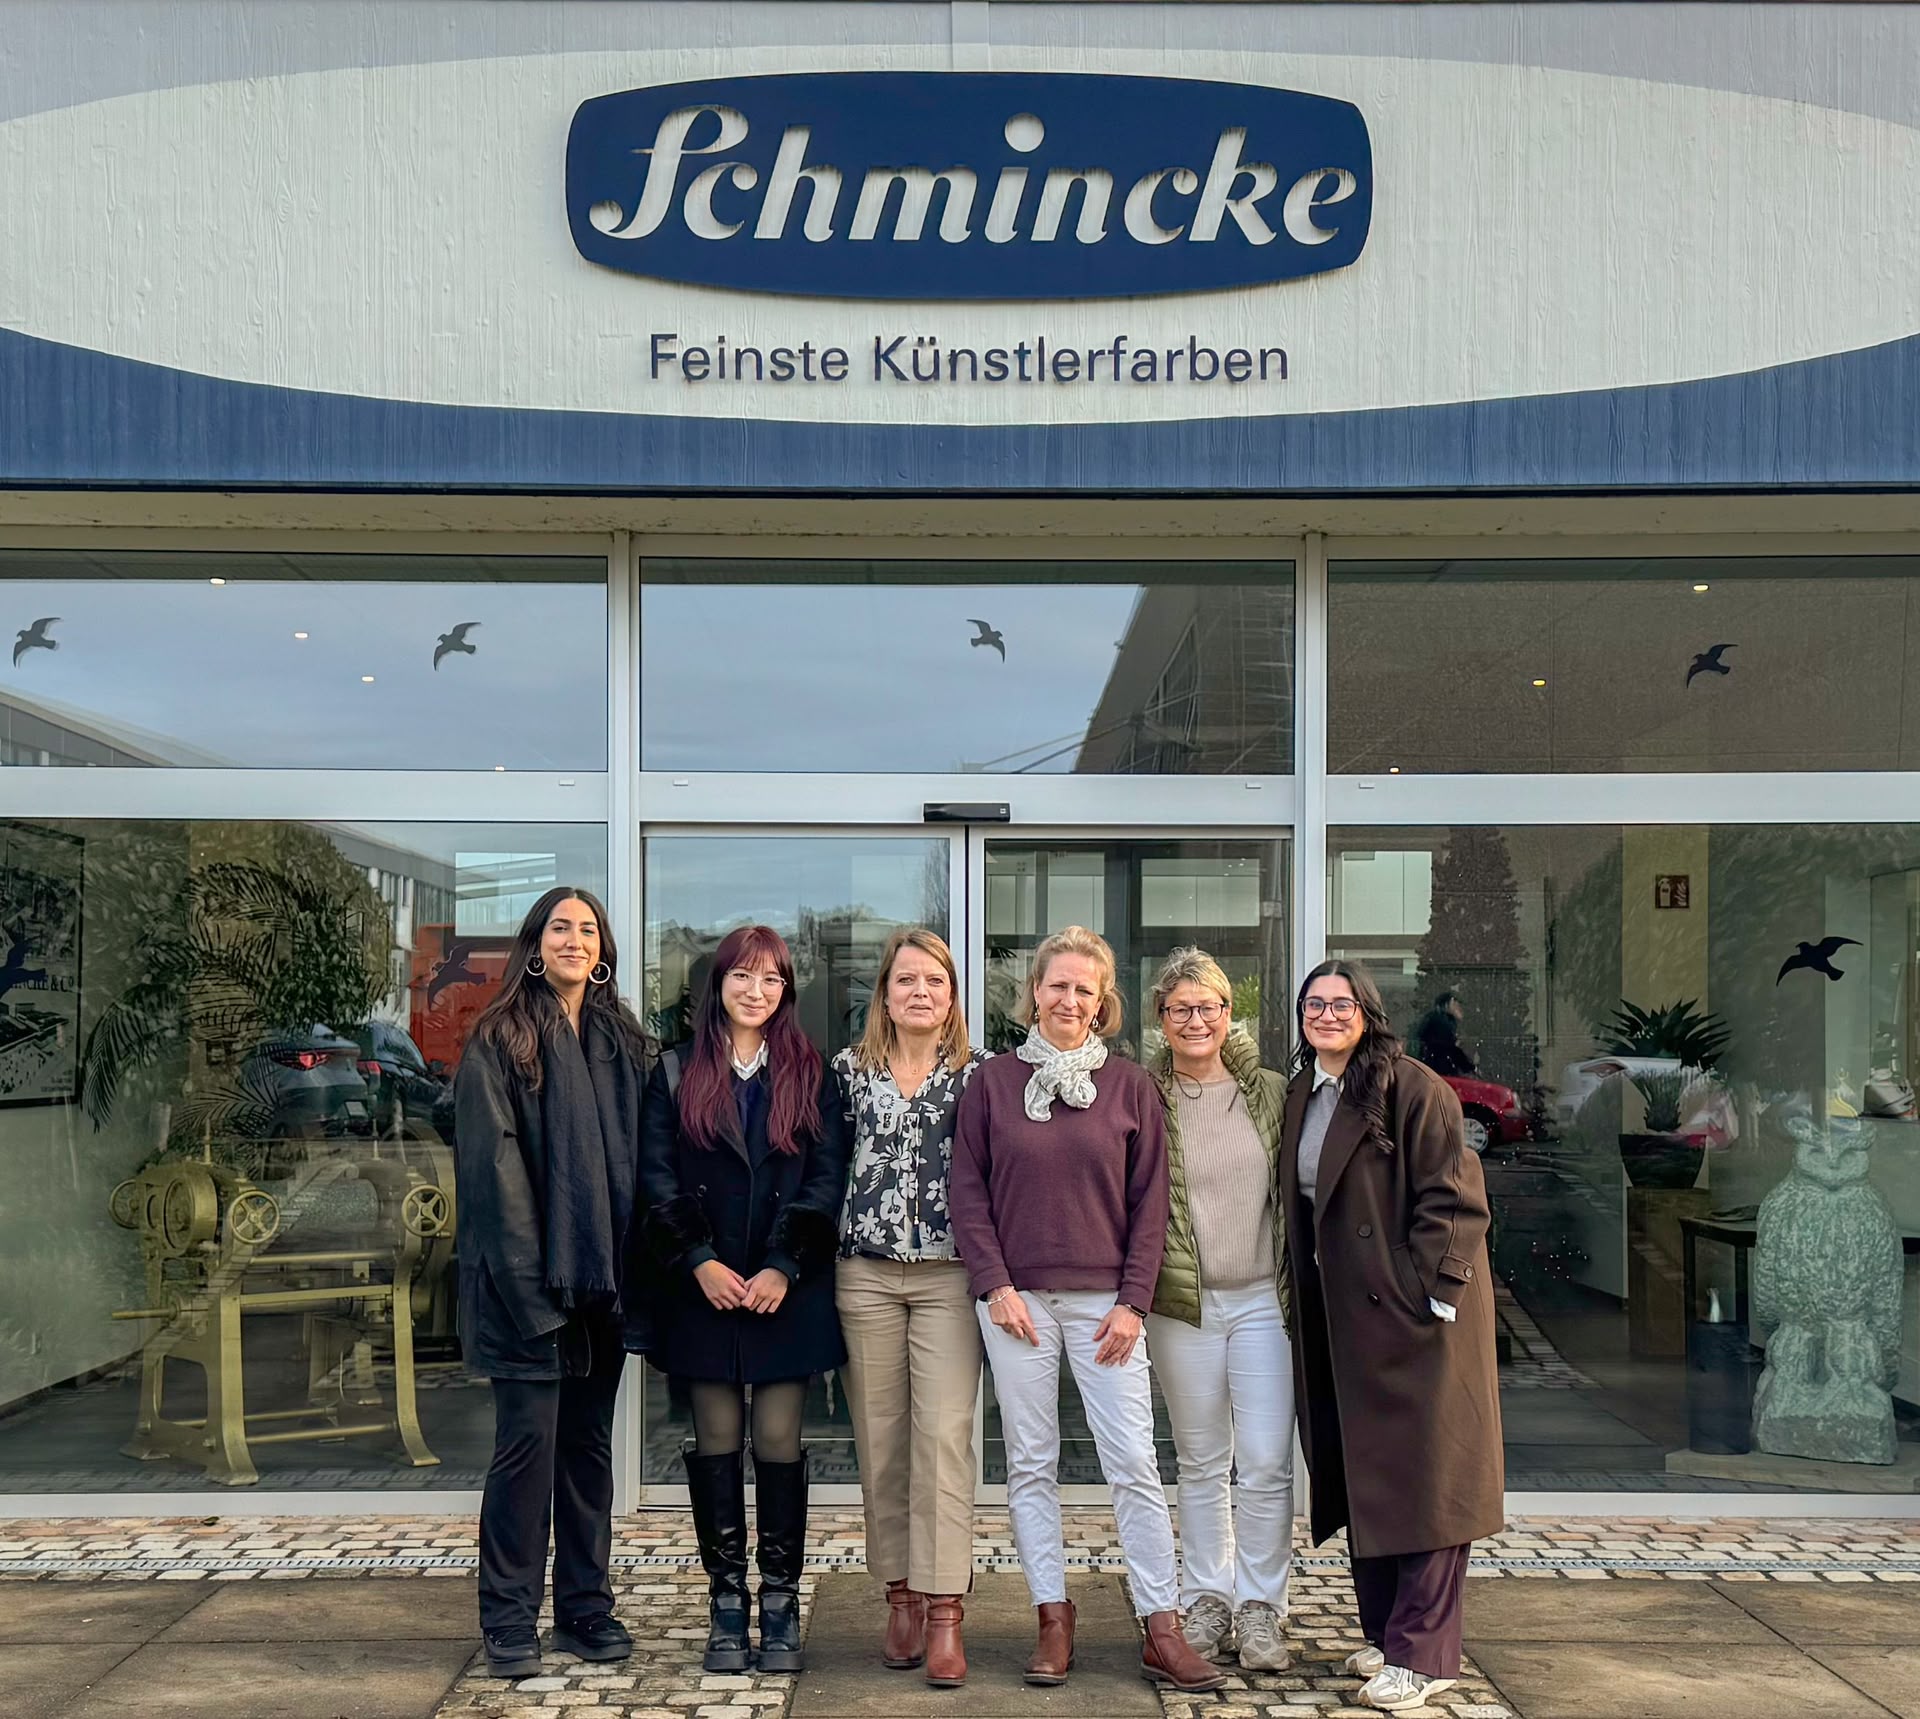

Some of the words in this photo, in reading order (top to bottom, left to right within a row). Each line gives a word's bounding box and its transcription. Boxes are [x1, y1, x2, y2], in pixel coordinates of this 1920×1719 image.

[589, 103, 1358, 245] Schmincke
[650, 333, 849, 383] Feinste
[874, 334, 1289, 383] Künstlerfarben
